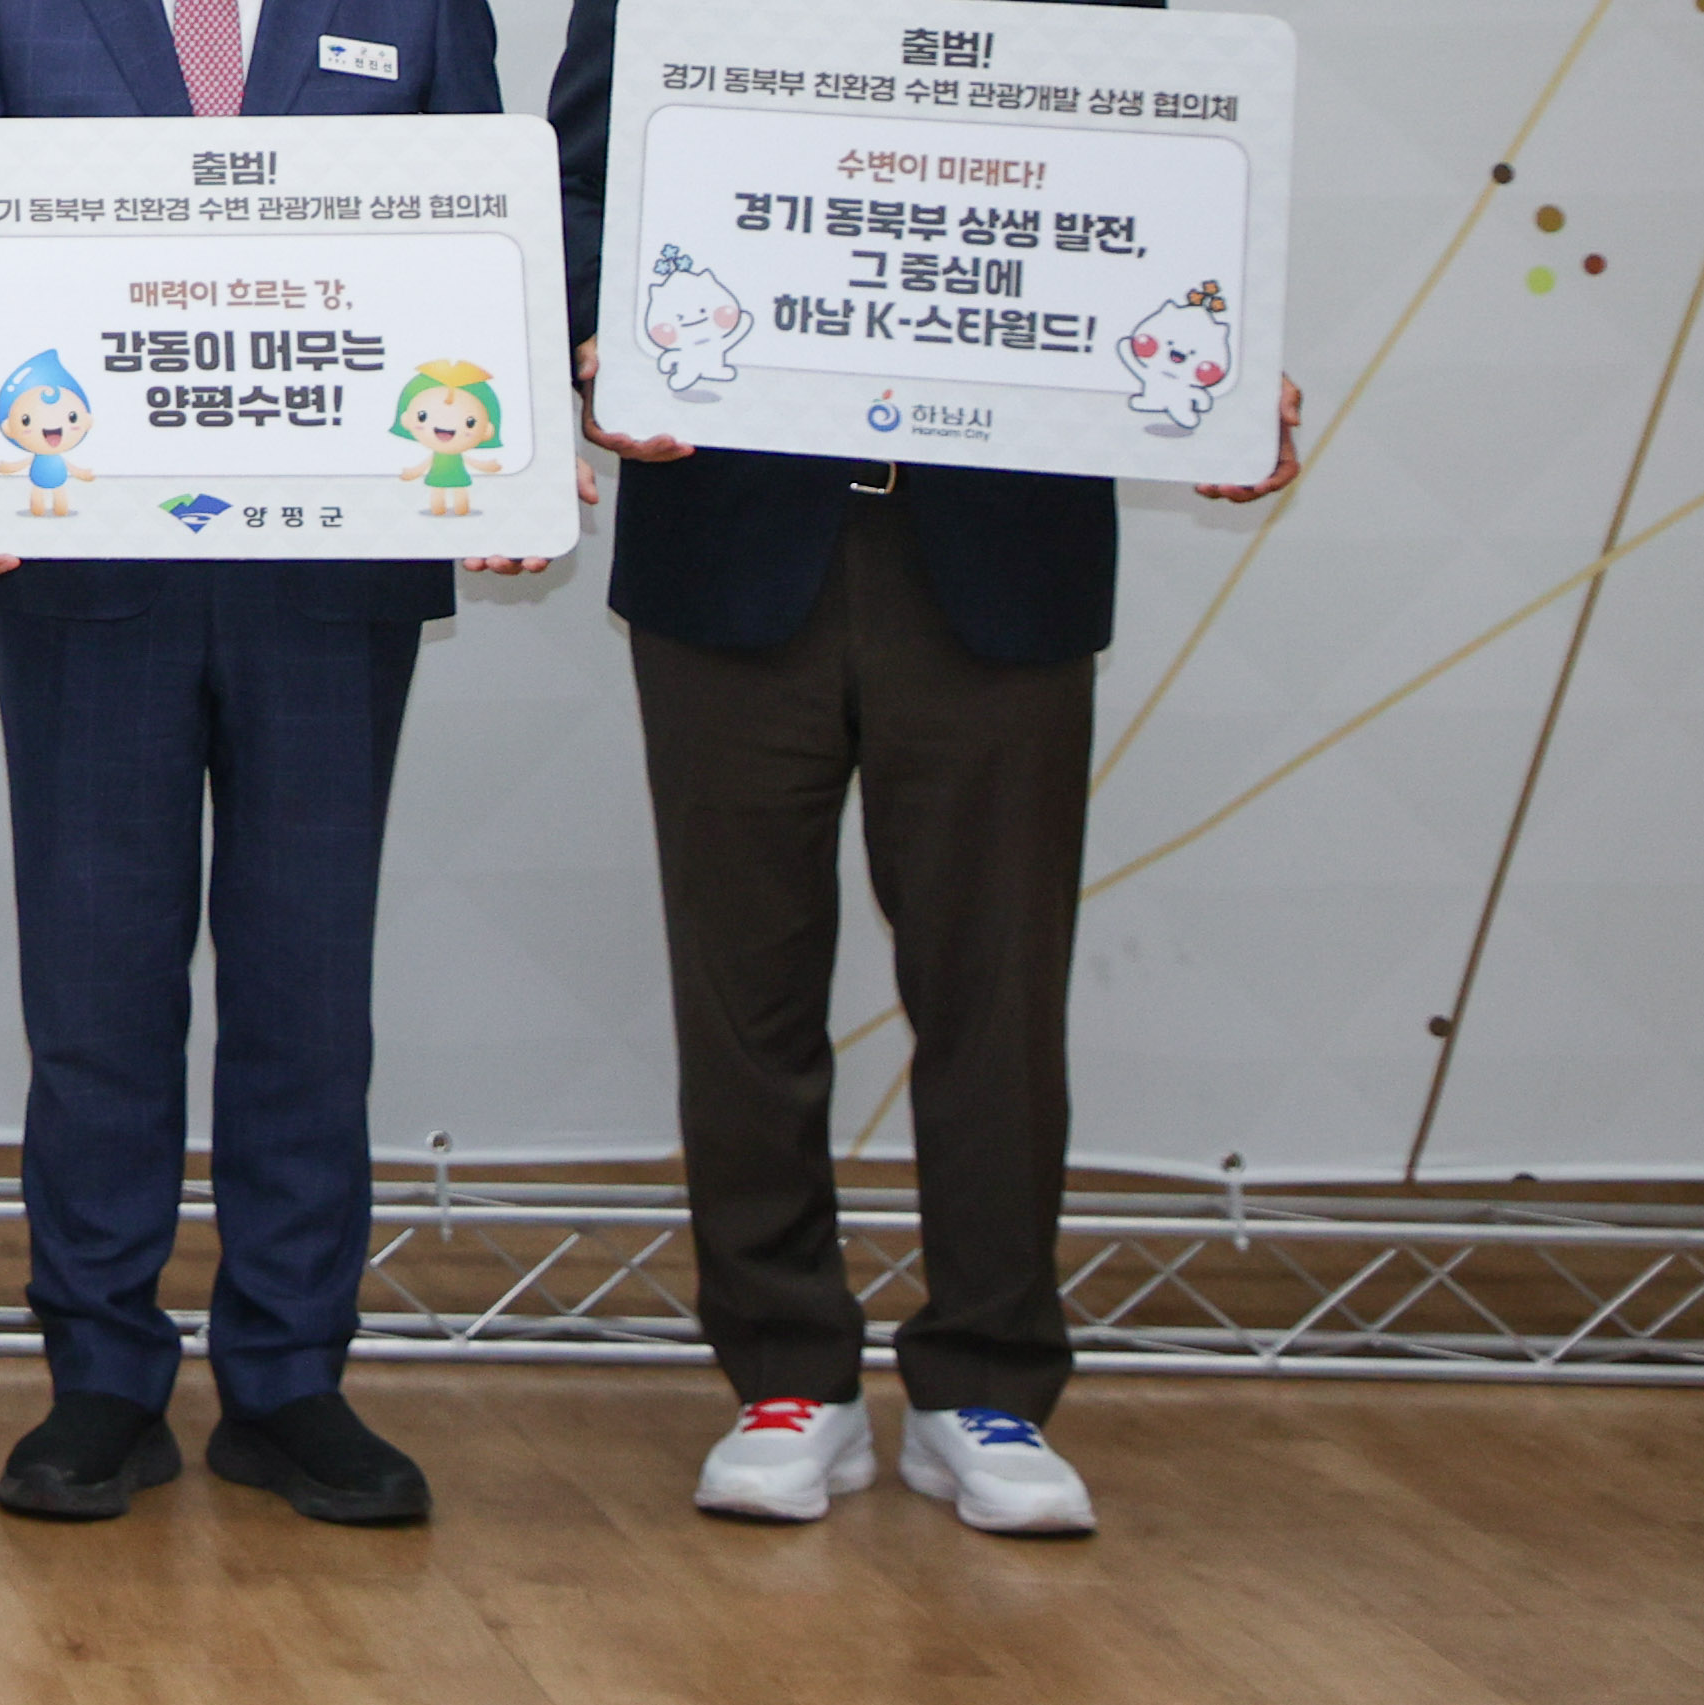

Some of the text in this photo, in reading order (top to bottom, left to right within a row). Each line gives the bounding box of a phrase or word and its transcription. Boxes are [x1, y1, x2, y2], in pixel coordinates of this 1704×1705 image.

[902, 28, 994, 68] 출범!
[663, 64, 1237, 121] 경기 동북부 친환경 수변 관광개발 상생 협의체
[193, 151, 276, 185] 출범!
[838, 150, 1045, 189] 수변이 미래다!
[30, 199, 105, 222] 동북부
[114, 198, 190, 221] 친환경
[199, 197, 249, 221] 수변
[258, 196, 362, 220] 관광개발
[370, 196, 420, 219] 상생
[430, 195, 507, 218] 협의체
[735, 193, 1146, 258] 경기 동북부 상생 발전,
[847, 250, 1022, 297] 그 중심에
[130, 279, 352, 310] 매력이 흐르는 강,
[774, 294, 1096, 353] 하남 K-스타월드!
[102, 330, 385, 372] 감동이 머무는
[147, 385, 343, 427] 양평수변!
[913, 405, 992, 427] 하남시
[244, 507, 343, 527] 양평군
